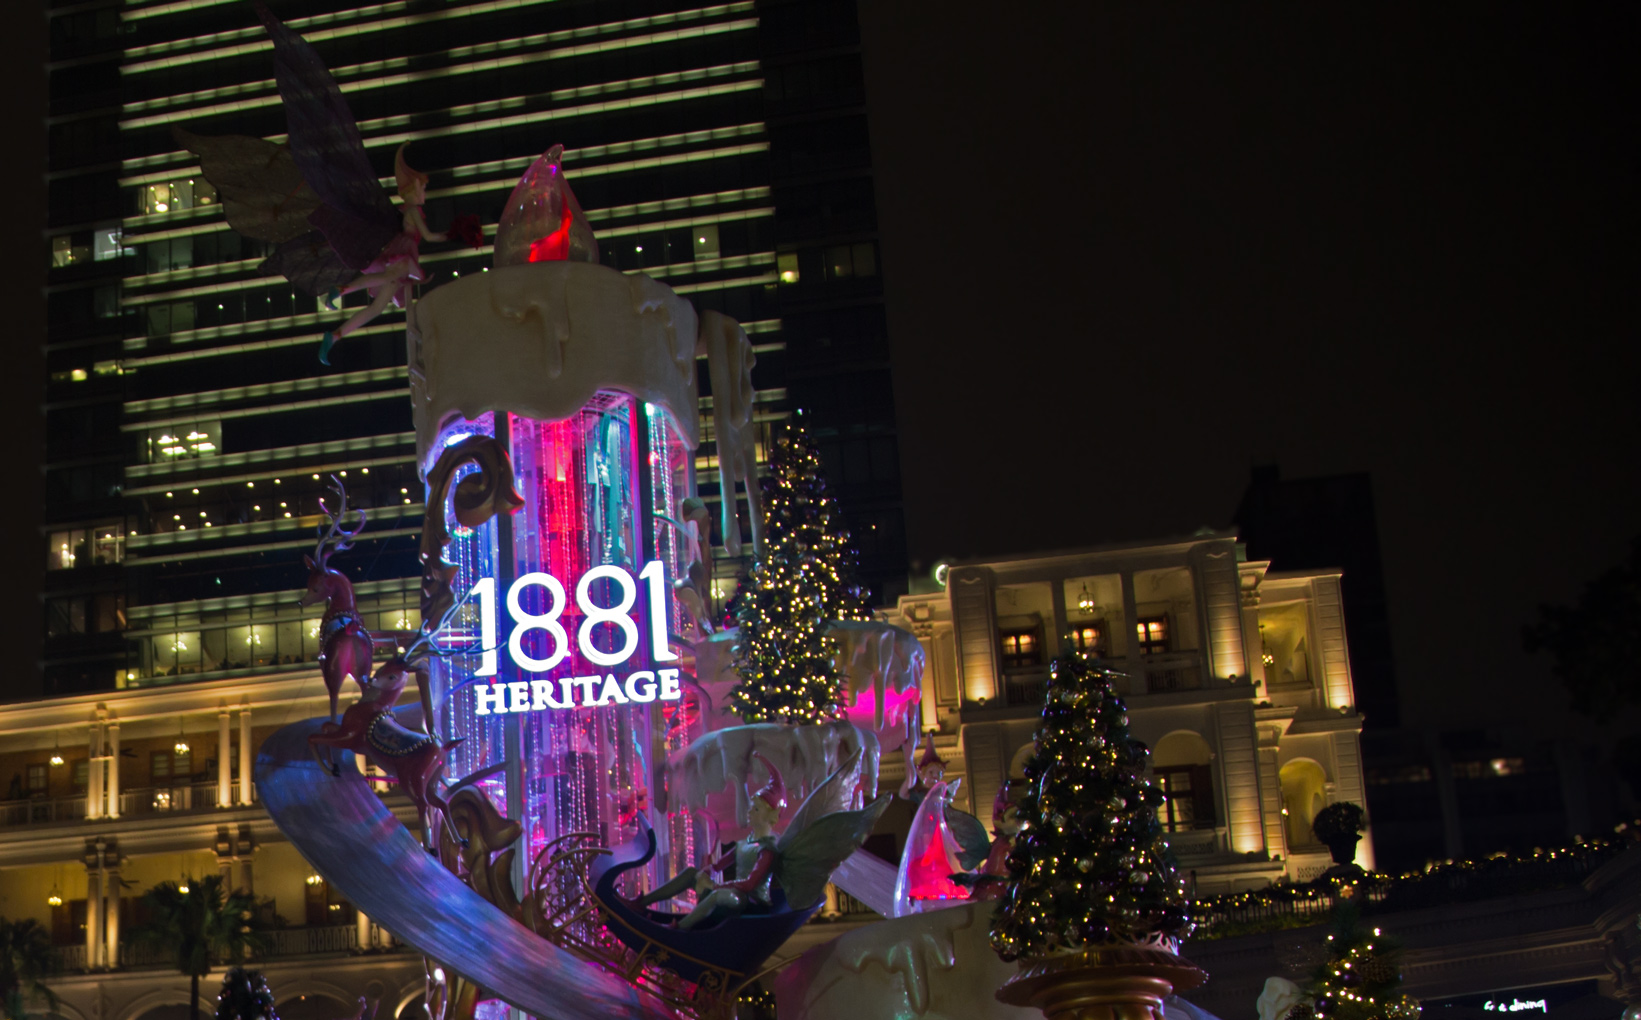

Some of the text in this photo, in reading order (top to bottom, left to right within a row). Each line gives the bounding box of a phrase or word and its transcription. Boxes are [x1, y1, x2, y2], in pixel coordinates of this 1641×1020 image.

[471, 560, 679, 676] 1881
[474, 668, 682, 715] HERITAGE
[1509, 999, 1547, 1013] dining
